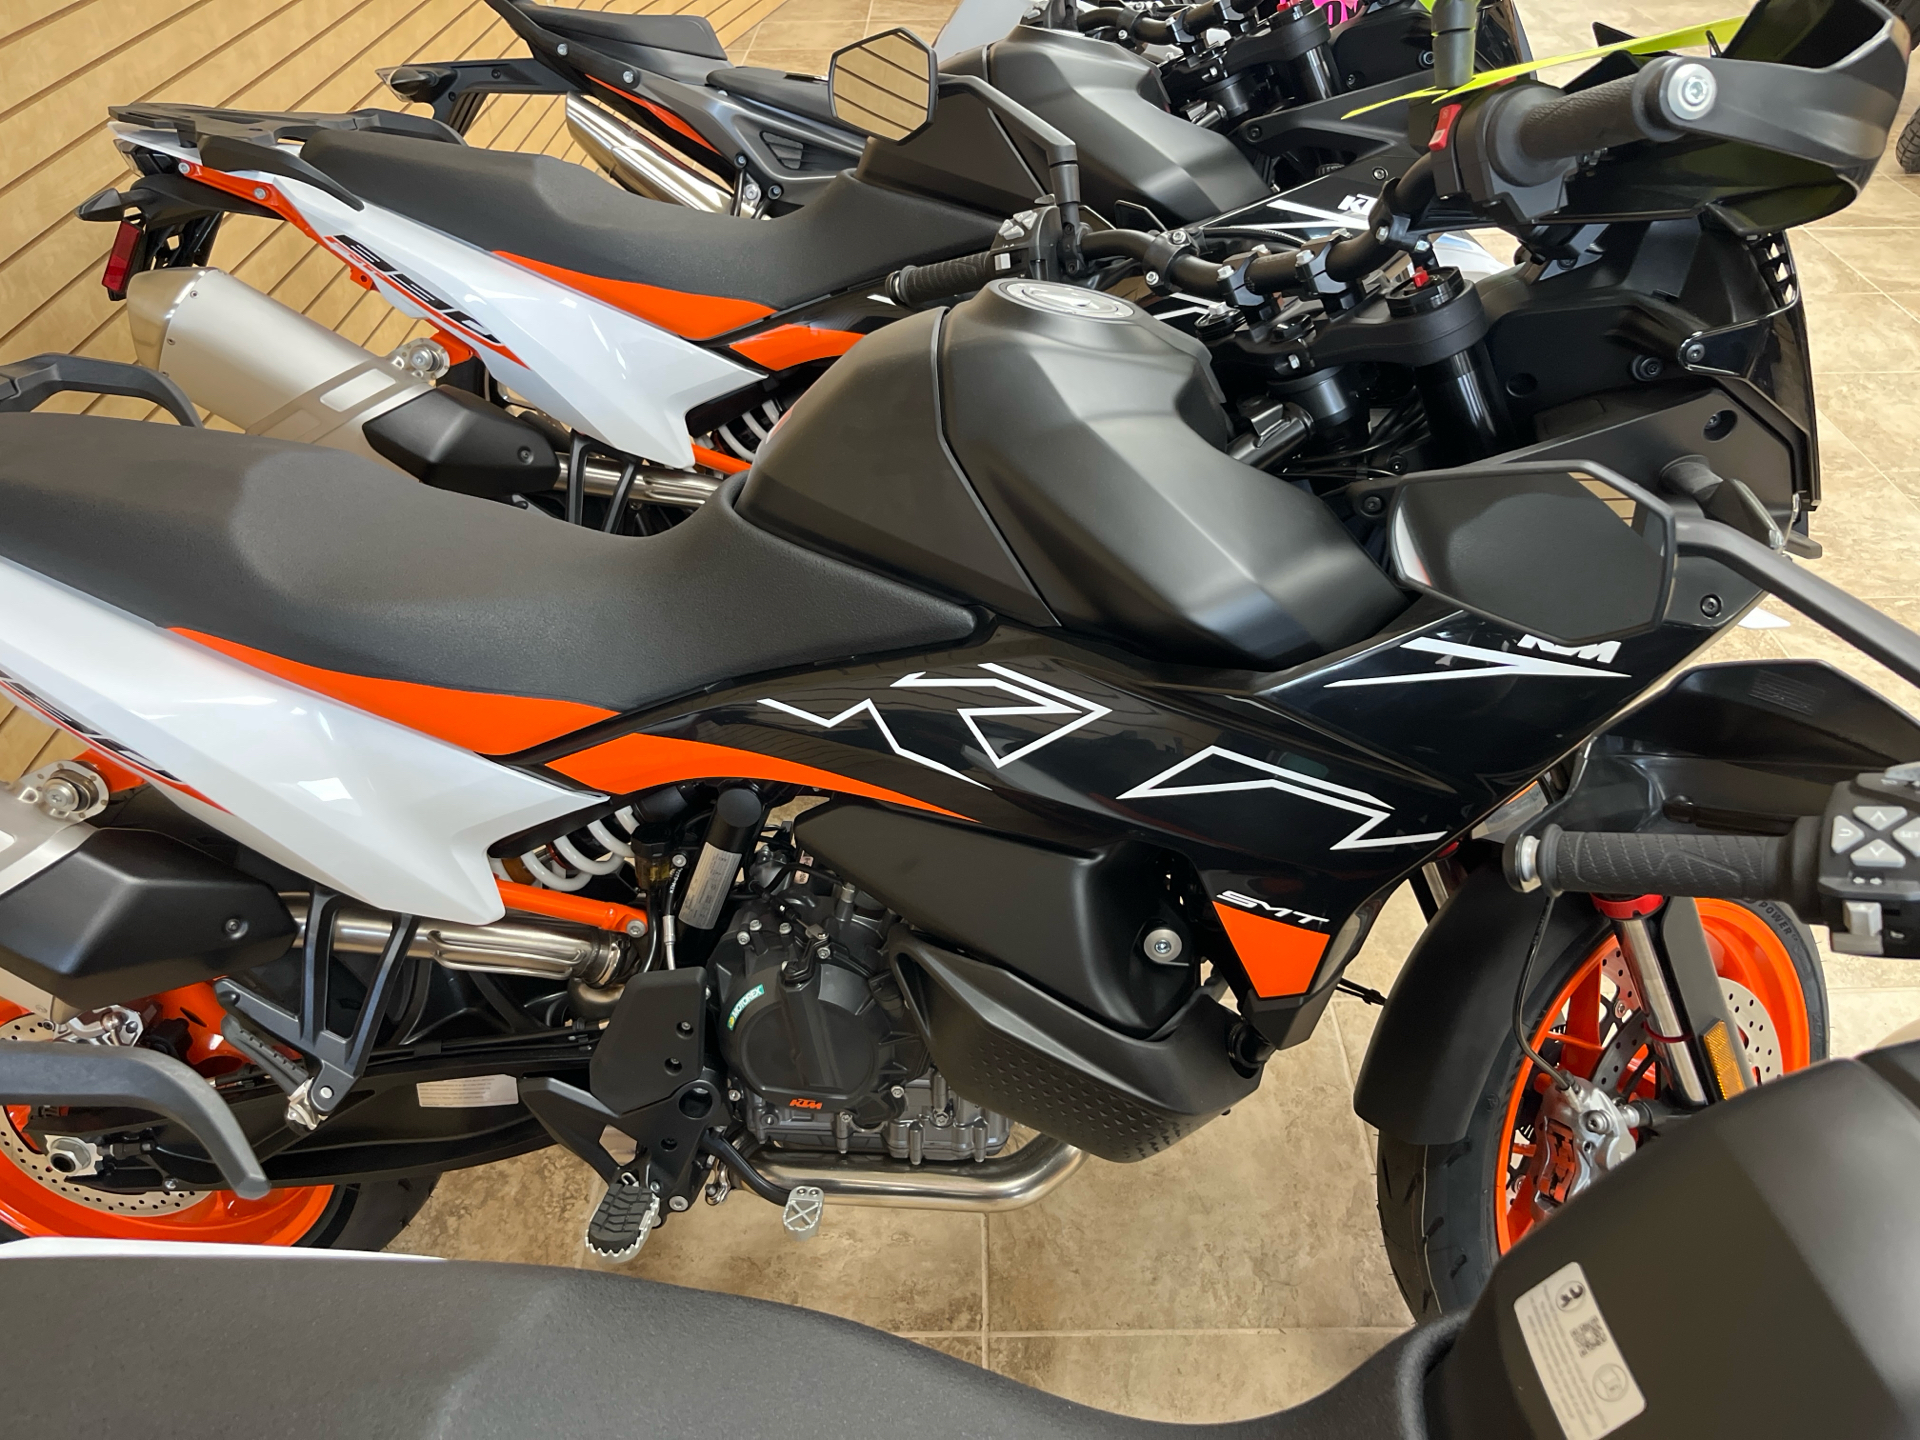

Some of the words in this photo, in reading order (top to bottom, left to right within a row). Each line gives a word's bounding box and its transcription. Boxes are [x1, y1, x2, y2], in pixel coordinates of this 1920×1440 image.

[1337, 193, 1378, 216] KT
[0, 669, 183, 783] 90
[1216, 890, 1330, 924] SMT
[1758, 901, 1792, 935] POWER
[732, 986, 762, 1018] MOTOREX
[789, 1098, 823, 1110] KTM
